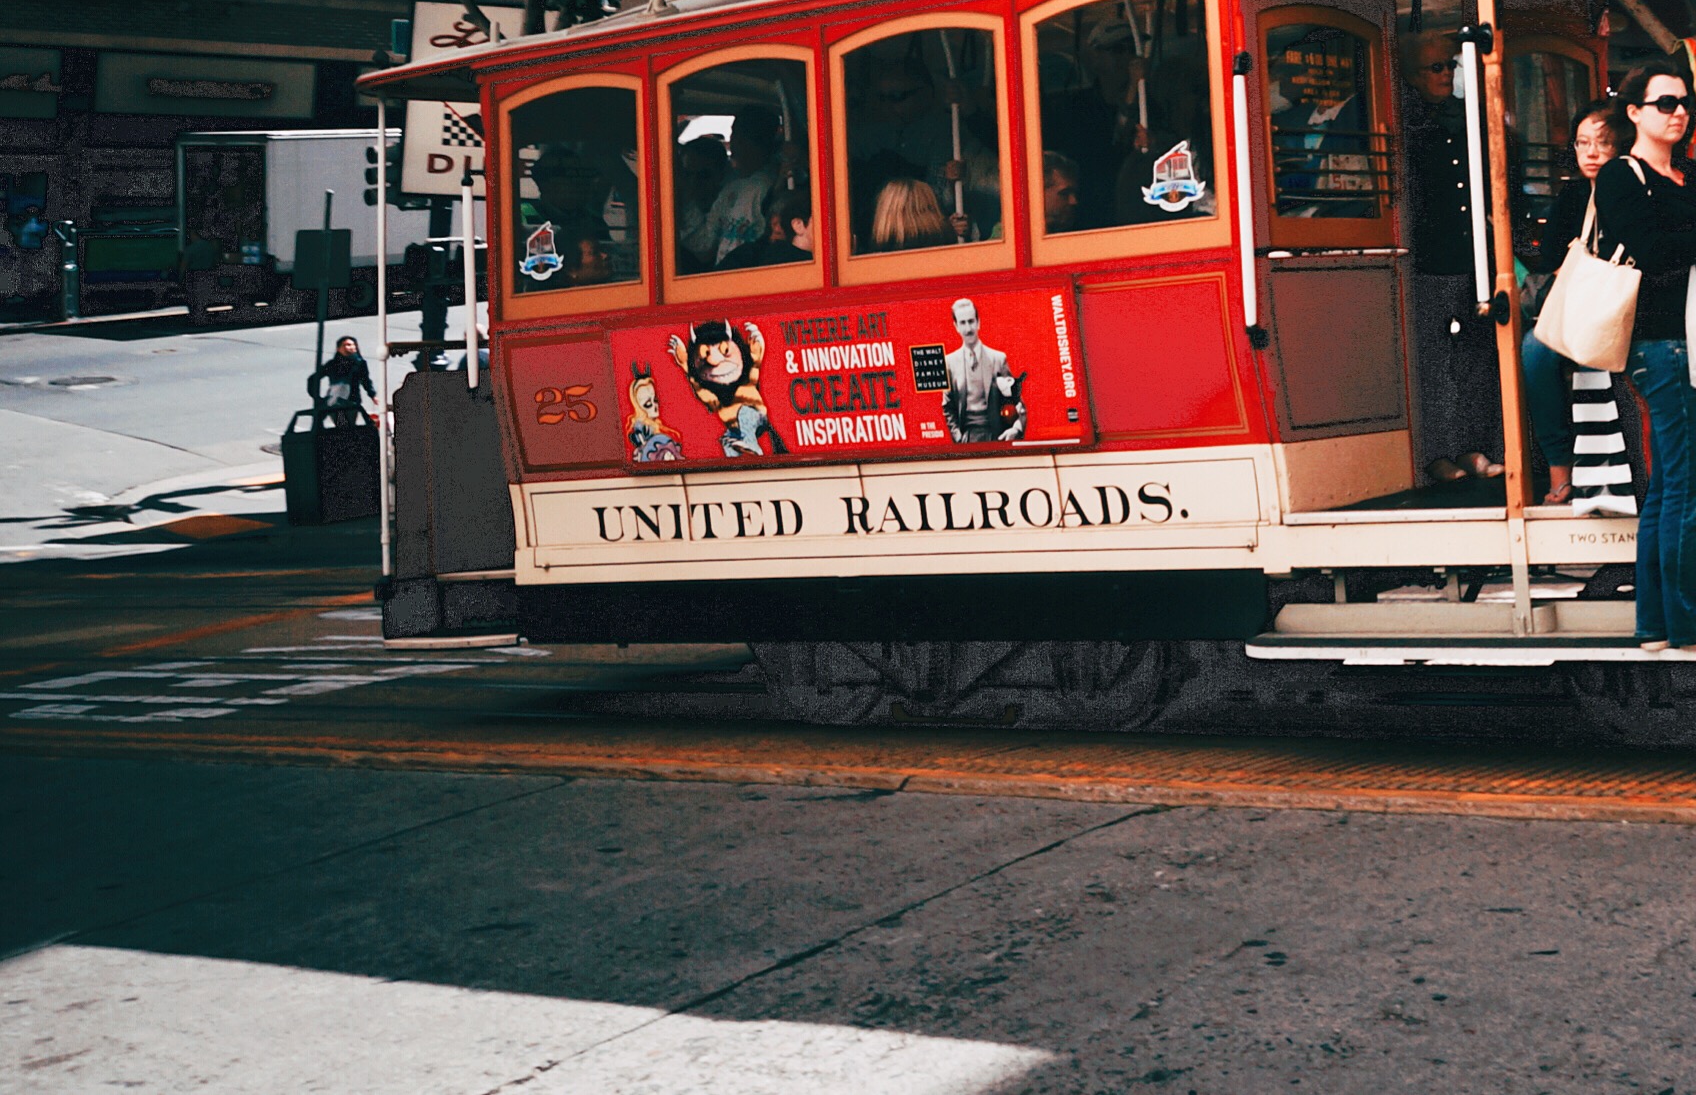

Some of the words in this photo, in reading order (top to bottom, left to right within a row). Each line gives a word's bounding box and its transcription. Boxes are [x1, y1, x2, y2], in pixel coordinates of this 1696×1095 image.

[780, 316, 852, 346] WHERE
[857, 312, 888, 340] ART
[1051, 294, 1077, 398] WALTDISNEY.ORG
[785, 350, 799, 374] &
[801, 341, 895, 372] INNOVATION
[534, 383, 598, 425] 25
[789, 370, 901, 416] CREATE
[795, 413, 907, 446] INSPIRATION
[592, 498, 803, 542] UNITED
[839, 482, 1189, 535] RAILROADS.
[1569, 534, 1597, 544] TWO
